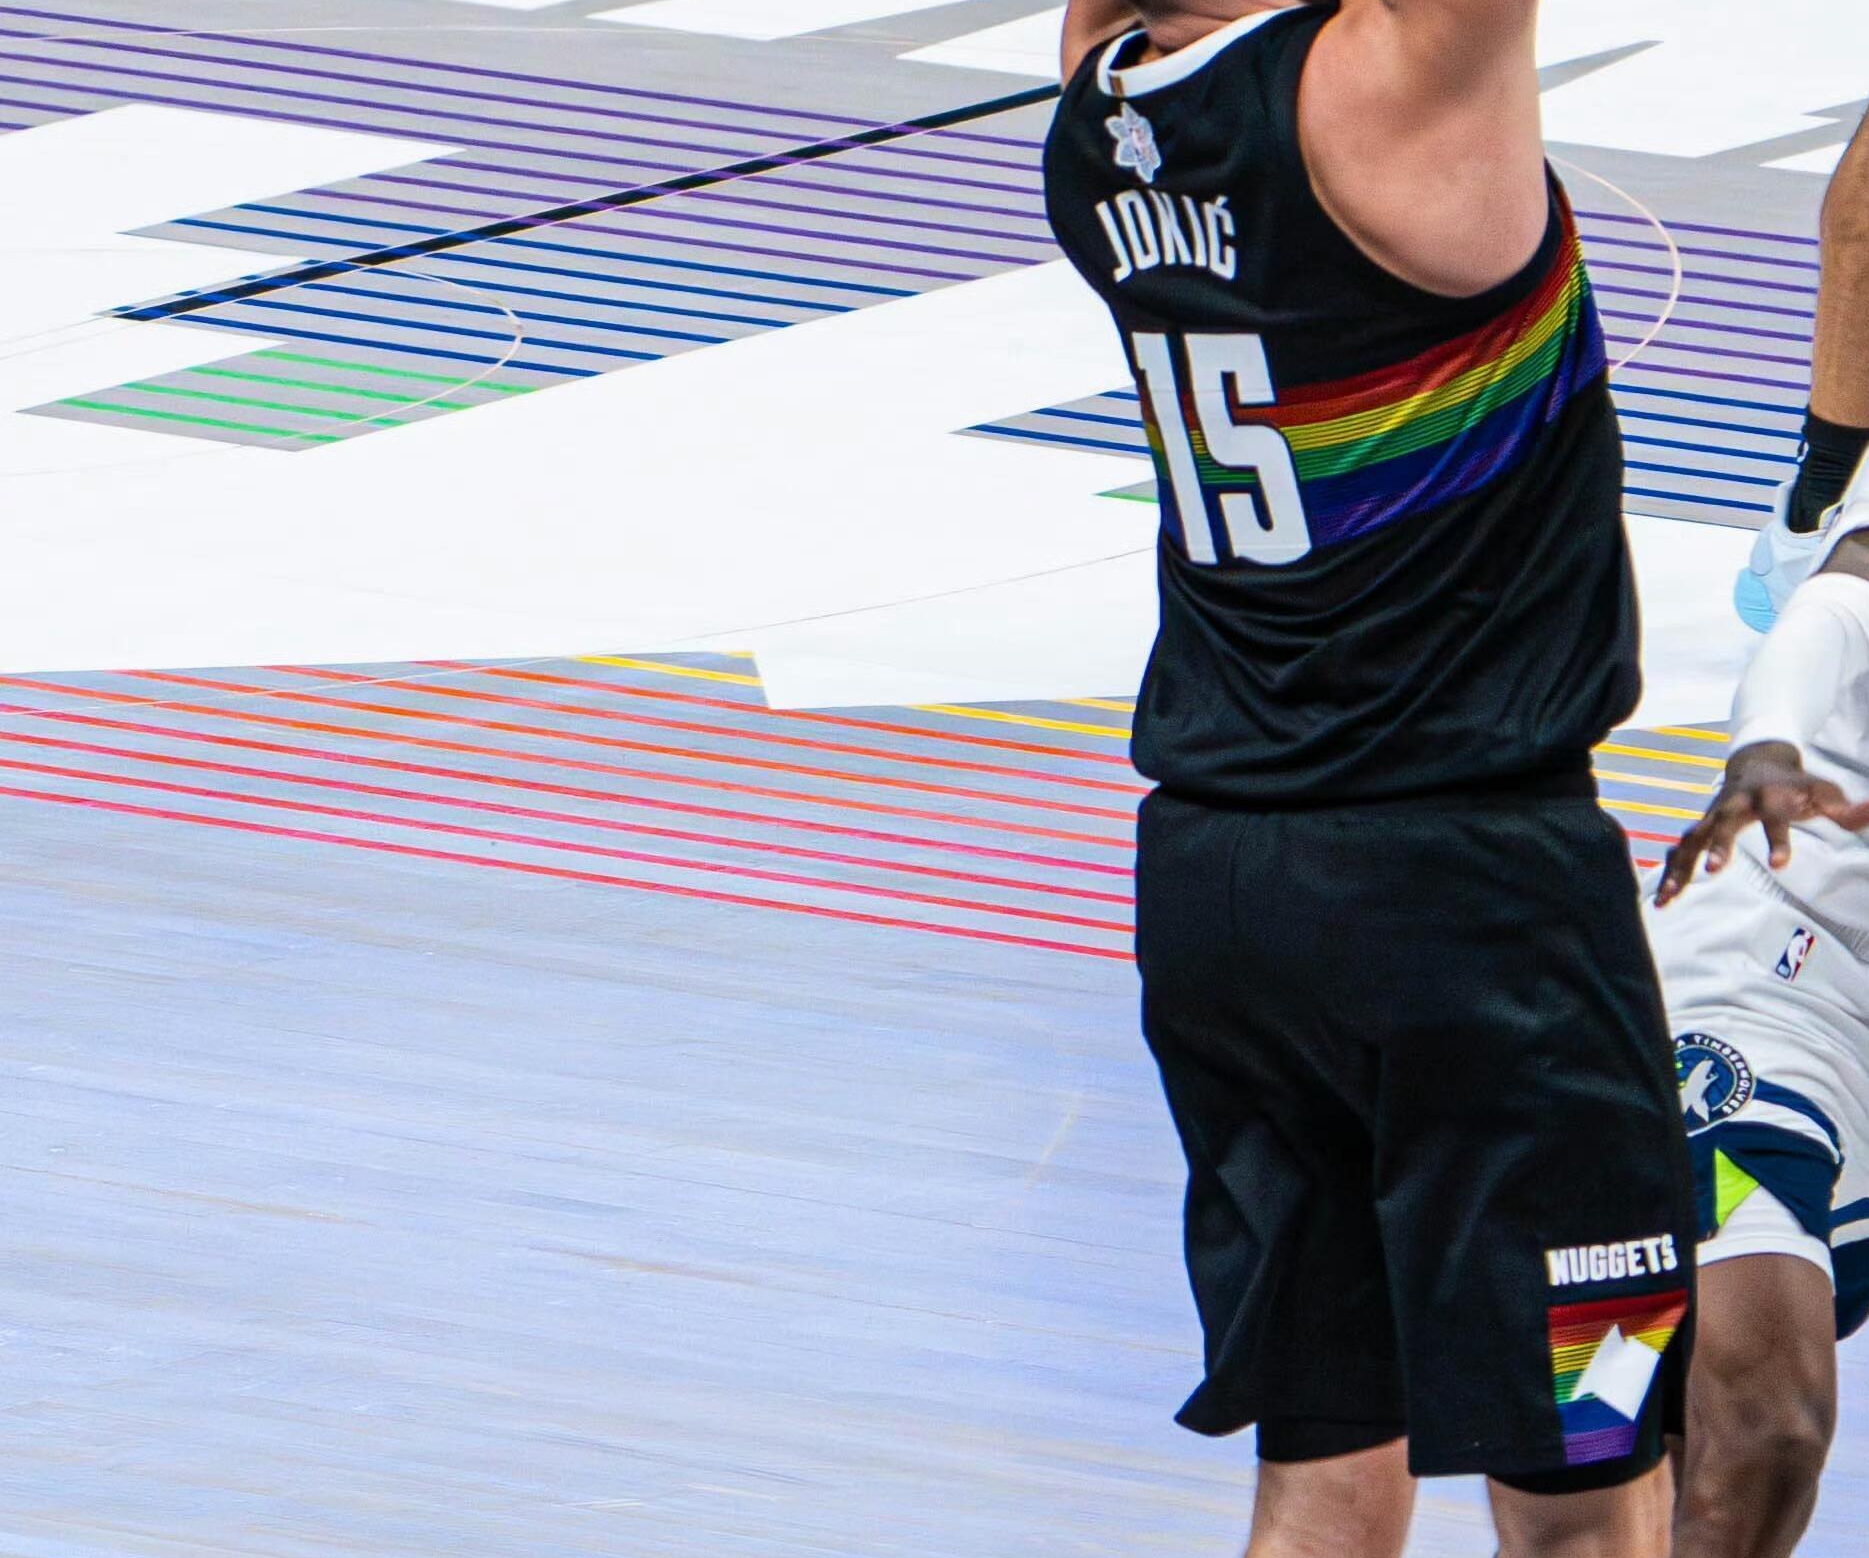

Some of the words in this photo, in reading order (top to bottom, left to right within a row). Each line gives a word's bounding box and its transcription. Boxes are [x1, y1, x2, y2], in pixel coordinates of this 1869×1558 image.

[1095, 188, 1239, 283] JOKIĆ
[1131, 330, 1313, 566] 15
[1544, 1232, 1679, 1288] NUGGETS
